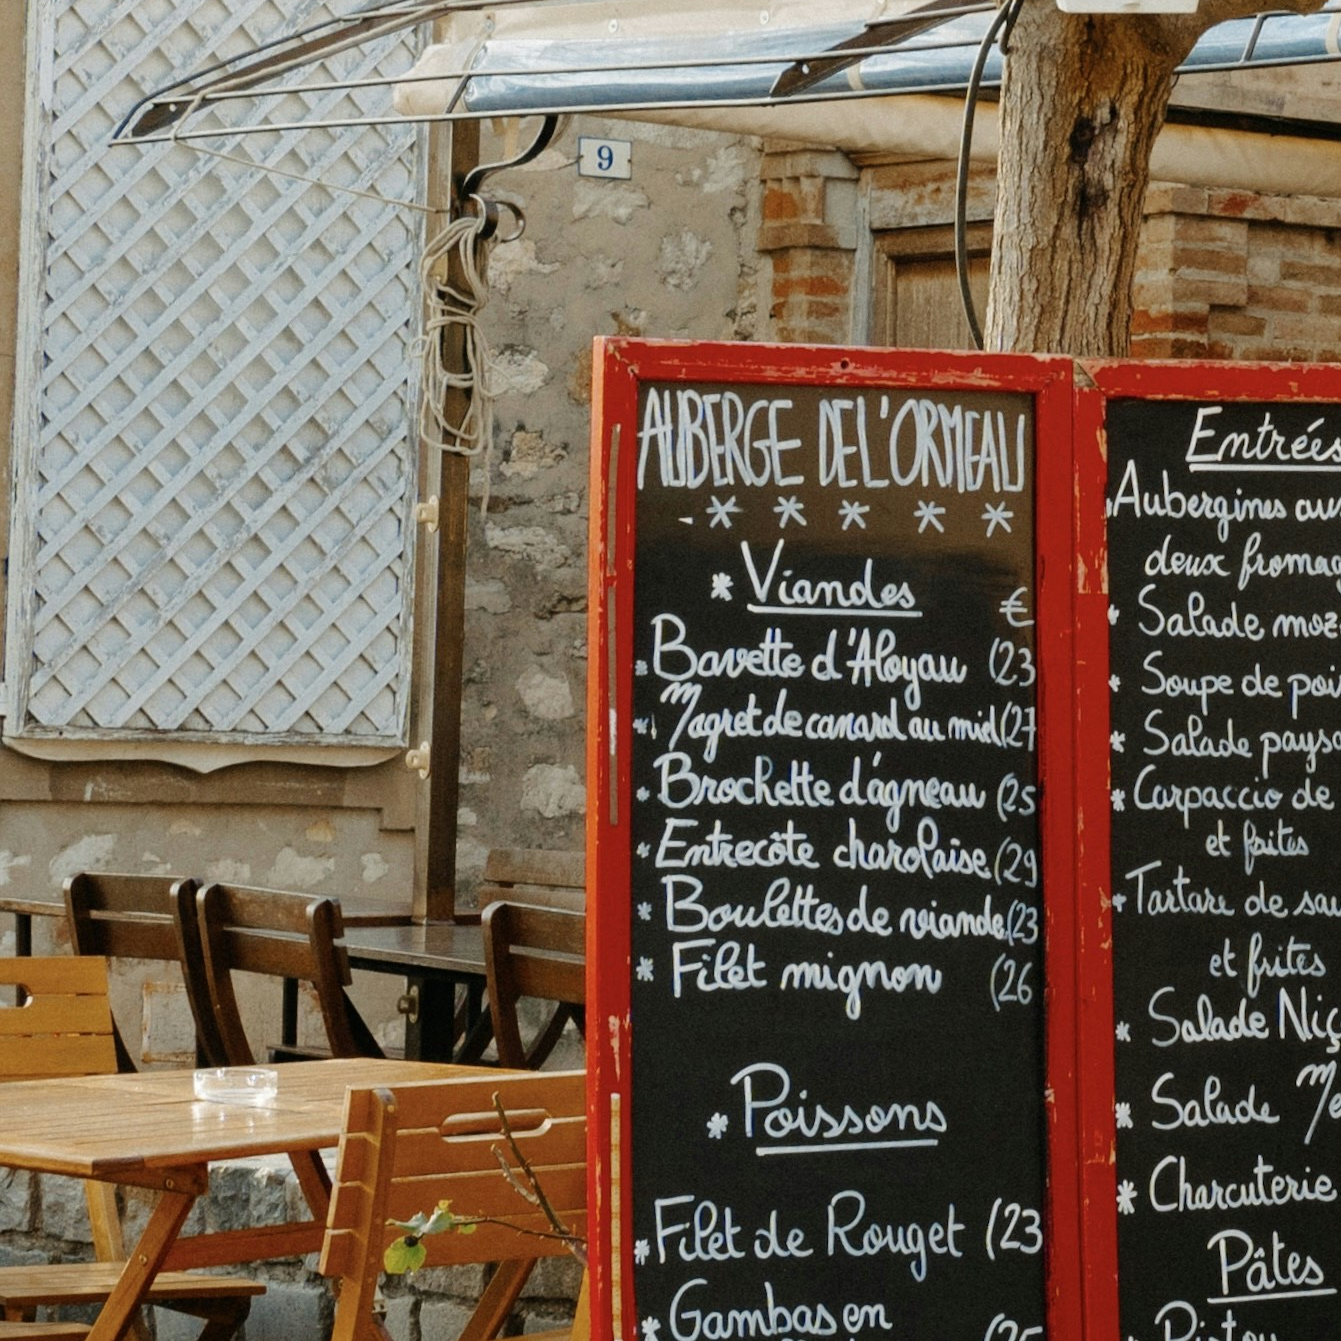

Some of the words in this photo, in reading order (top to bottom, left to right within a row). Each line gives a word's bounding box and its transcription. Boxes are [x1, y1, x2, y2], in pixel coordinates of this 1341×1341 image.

[597, 145, 613, 171] 9
[637, 387, 804, 490] AUBERGE
[1112, 459, 1287, 543] Aubergines
[741, 538, 916, 607] Viandes
[999, 587, 1034, 628] €
[1144, 534, 1231, 578] deux
[1138, 583, 1265, 641] Salade
[650, 613, 806, 681] Bavette
[811, 628, 967, 710] d'Aloyau
[1140, 650, 1234, 717] Soupe
[1241, 663, 1283, 698] de
[659, 682, 762, 763] Magret
[764, 688, 803, 738] de
[806, 697, 906, 741] canard
[908, 716, 945, 741] au
[1143, 709, 1253, 758] Salade
[653, 751, 831, 809] Brochette
[839, 751, 986, 832] d'agneau
[1133, 764, 1283, 829] Carpaccio
[1291, 778, 1335, 811] de
[655, 818, 820, 869] Entrecôte
[833, 817, 992, 878] charolaise
[1205, 819, 1231, 856] et
[660, 874, 844, 935] Boulettes
[847, 884, 893, 937] de
[900, 894, 1008, 939] viande
[1125, 860, 1235, 916] Tartare
[1244, 880, 1289, 919] de
[672, 939, 768, 998] Filet
[780, 952, 942, 1020] mignon
[1209, 938, 1238, 978] et
[1246, 931, 1326, 998] frites
[1148, 986, 1270, 1048] Salade
[730, 1062, 947, 1138] Poissons
[1151, 1072, 1281, 1130] Salade
[1149, 1154, 1338, 1213] Charcuterie
[654, 1194, 746, 1264] Filet
[753, 1210, 814, 1258] de
[827, 1190, 966, 1282] Rouget
[1206, 1228, 1325, 1295] Pâtes
[843, 1302, 893, 1330] en
